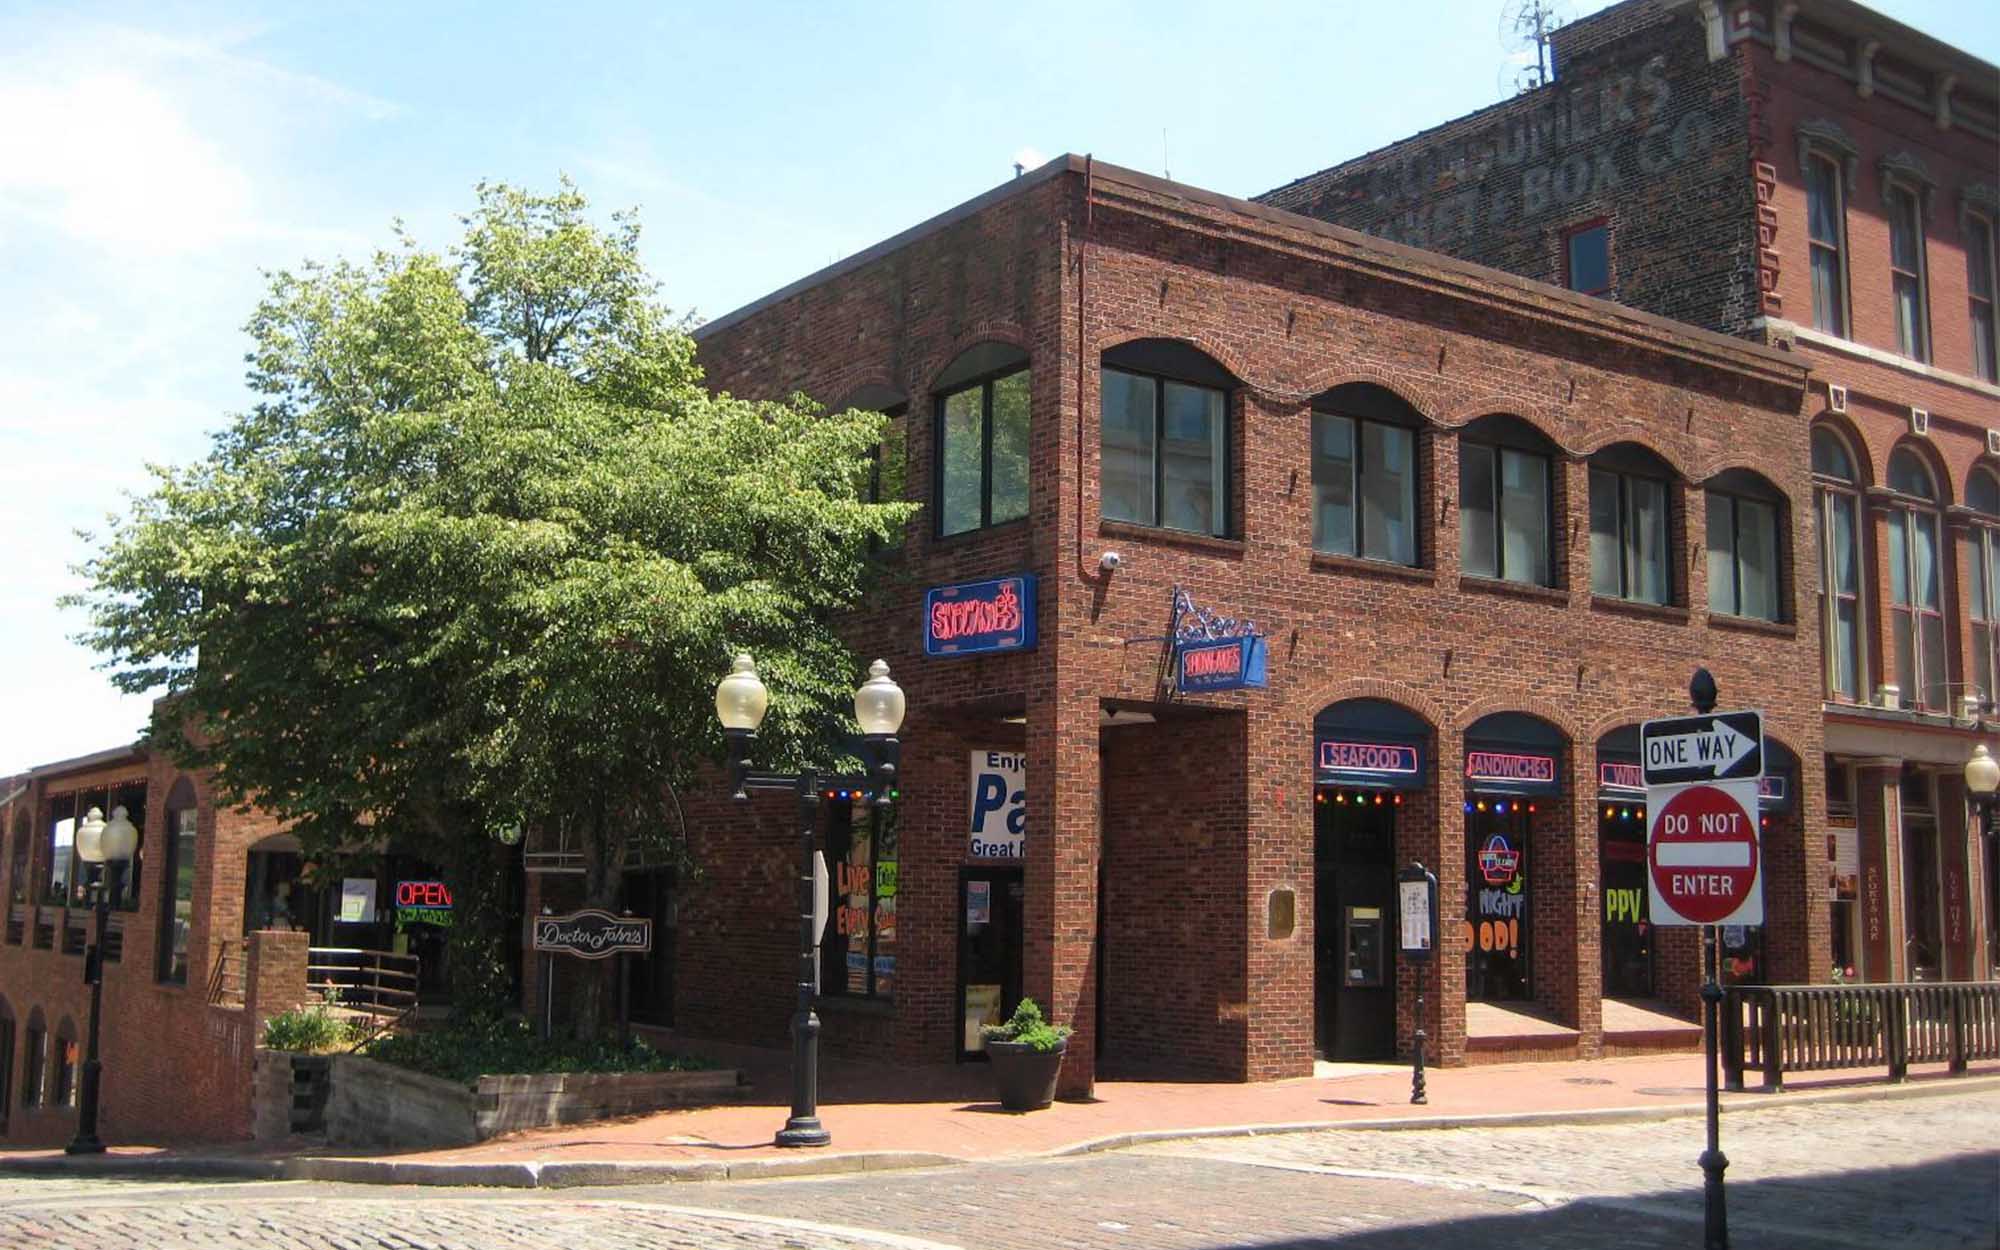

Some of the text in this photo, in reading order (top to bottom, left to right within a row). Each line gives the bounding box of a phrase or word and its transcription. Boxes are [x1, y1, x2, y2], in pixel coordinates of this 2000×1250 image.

[1330, 746, 1401, 769] SEAFOOD
[1650, 734, 1737, 765] ONE WAY
[1471, 755, 1549, 778] SANDWICHES
[1614, 767, 1642, 787] WIN
[1664, 813, 1740, 834] DO NOT
[971, 838, 1015, 857] Great
[399, 882, 453, 905] OPEN
[1671, 874, 1734, 896] ENTER
[1606, 888, 1642, 924] PPV
[538, 922, 642, 949] Doctor John's
